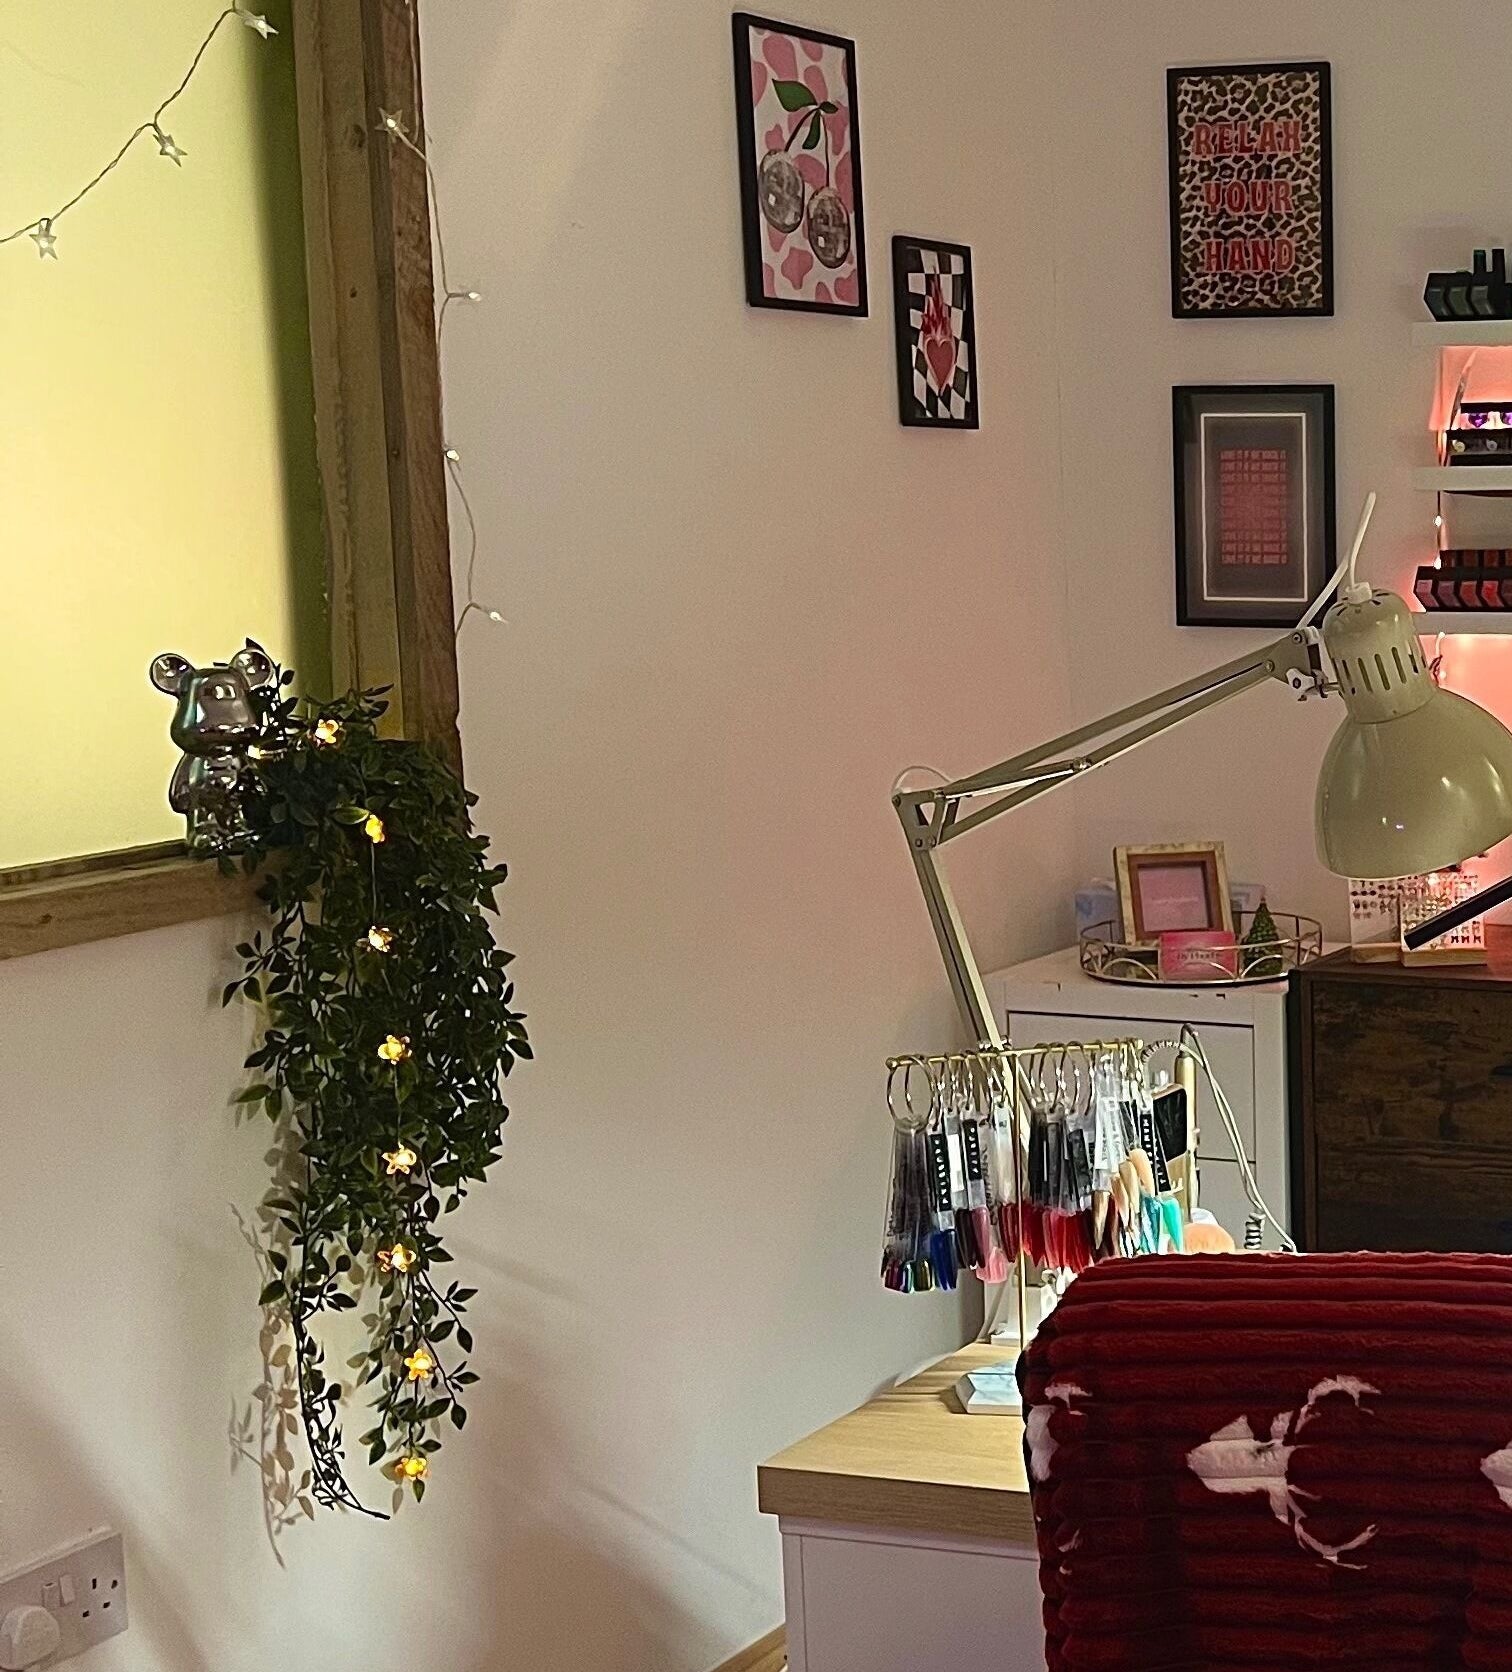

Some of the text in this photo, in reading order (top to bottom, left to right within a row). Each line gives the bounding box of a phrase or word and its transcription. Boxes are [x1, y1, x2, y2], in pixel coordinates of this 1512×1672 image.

[1193, 120, 1302, 157] RELAX
[1203, 179, 1294, 214] YOUR
[1203, 238, 1296, 272] HAND
